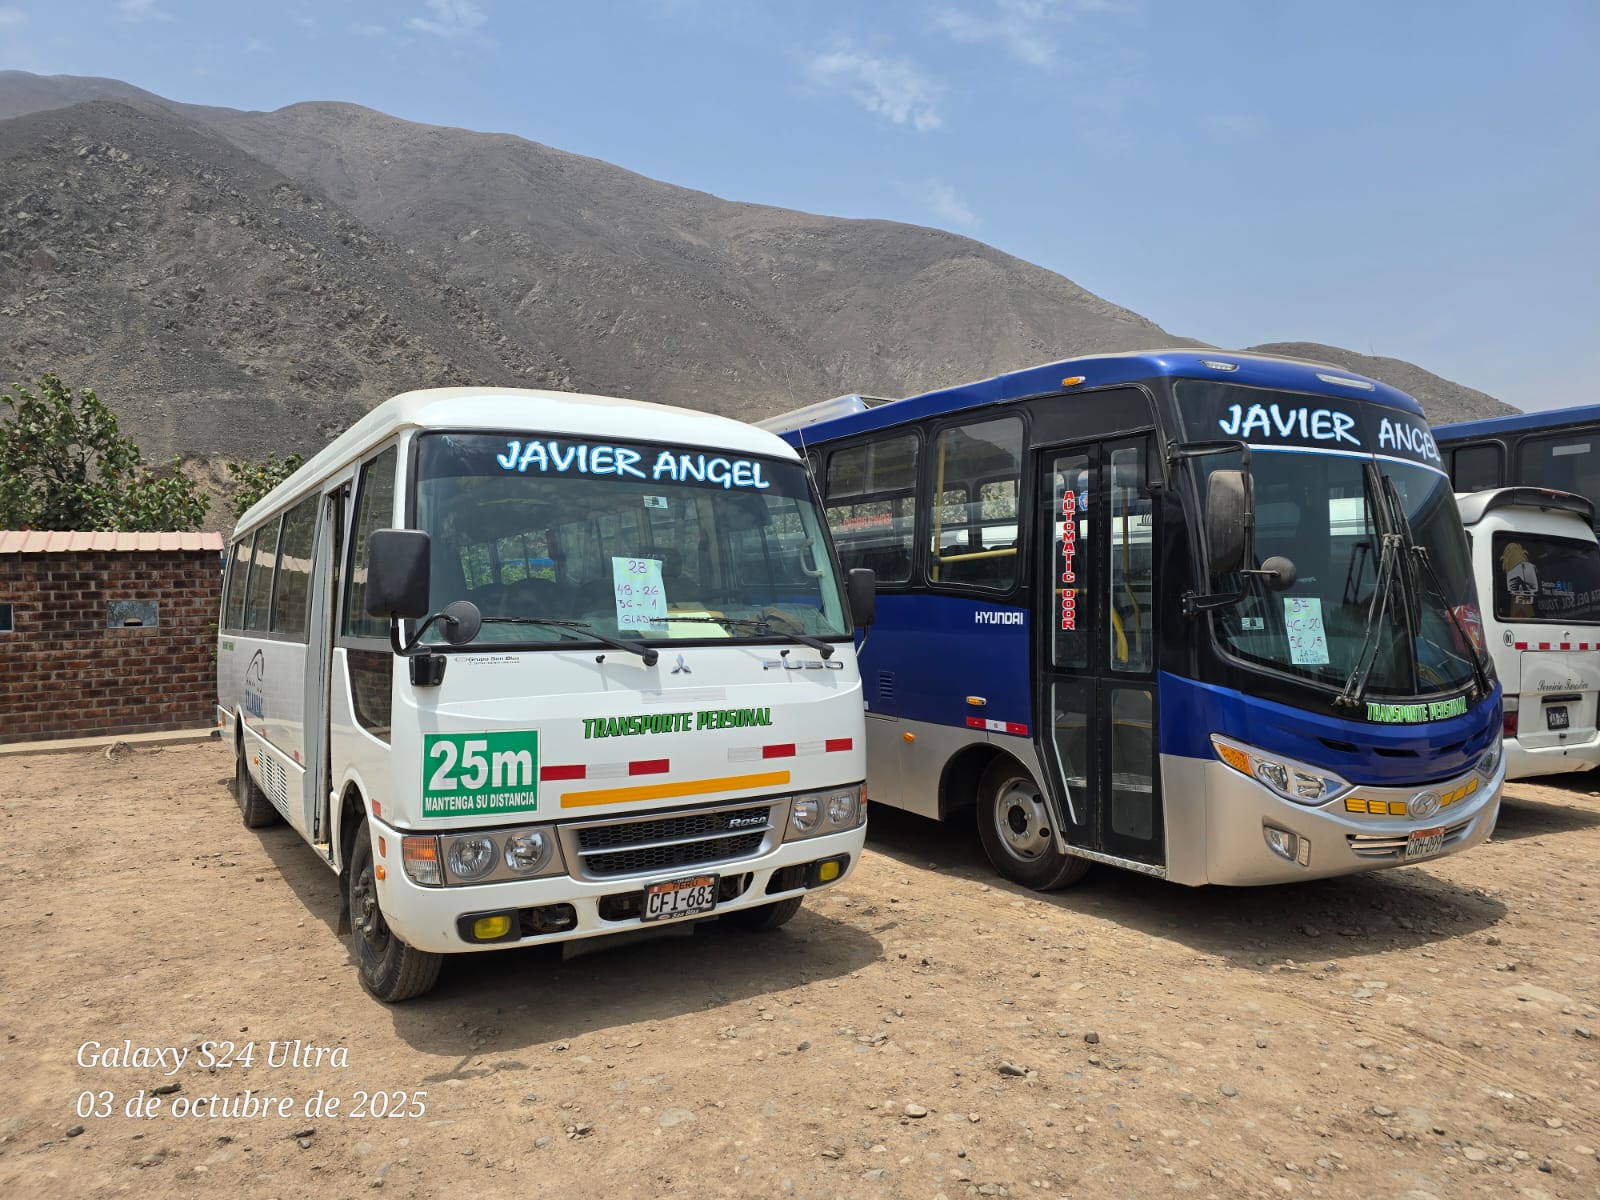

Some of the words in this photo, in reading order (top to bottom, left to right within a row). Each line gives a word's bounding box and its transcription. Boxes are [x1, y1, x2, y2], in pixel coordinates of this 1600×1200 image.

[1218, 403, 1361, 446] JAVIER
[1378, 417, 1441, 461] ANGEL
[497, 440, 647, 479] JAVIER
[652, 450, 770, 489] ANGEL
[1062, 490, 1075, 583] AUTOMATIC
[628, 560, 647, 574] 28
[975, 611, 1024, 625] HYUNDAI
[1062, 588, 1075, 630] DOOR
[582, 712, 693, 739] TRANSPORTE
[696, 707, 773, 730] PERSONAL
[1366, 702, 1428, 722] TRANSPORTE
[1428, 696, 1468, 720] PERSONAL
[428, 740, 533, 791] 25m
[424, 796, 474, 811] MANTENGA
[476, 794, 488, 808] SU
[490, 791, 535, 808] DISTANCIA
[728, 816, 767, 828] Rosa
[649, 884, 714, 914] CFI-683
